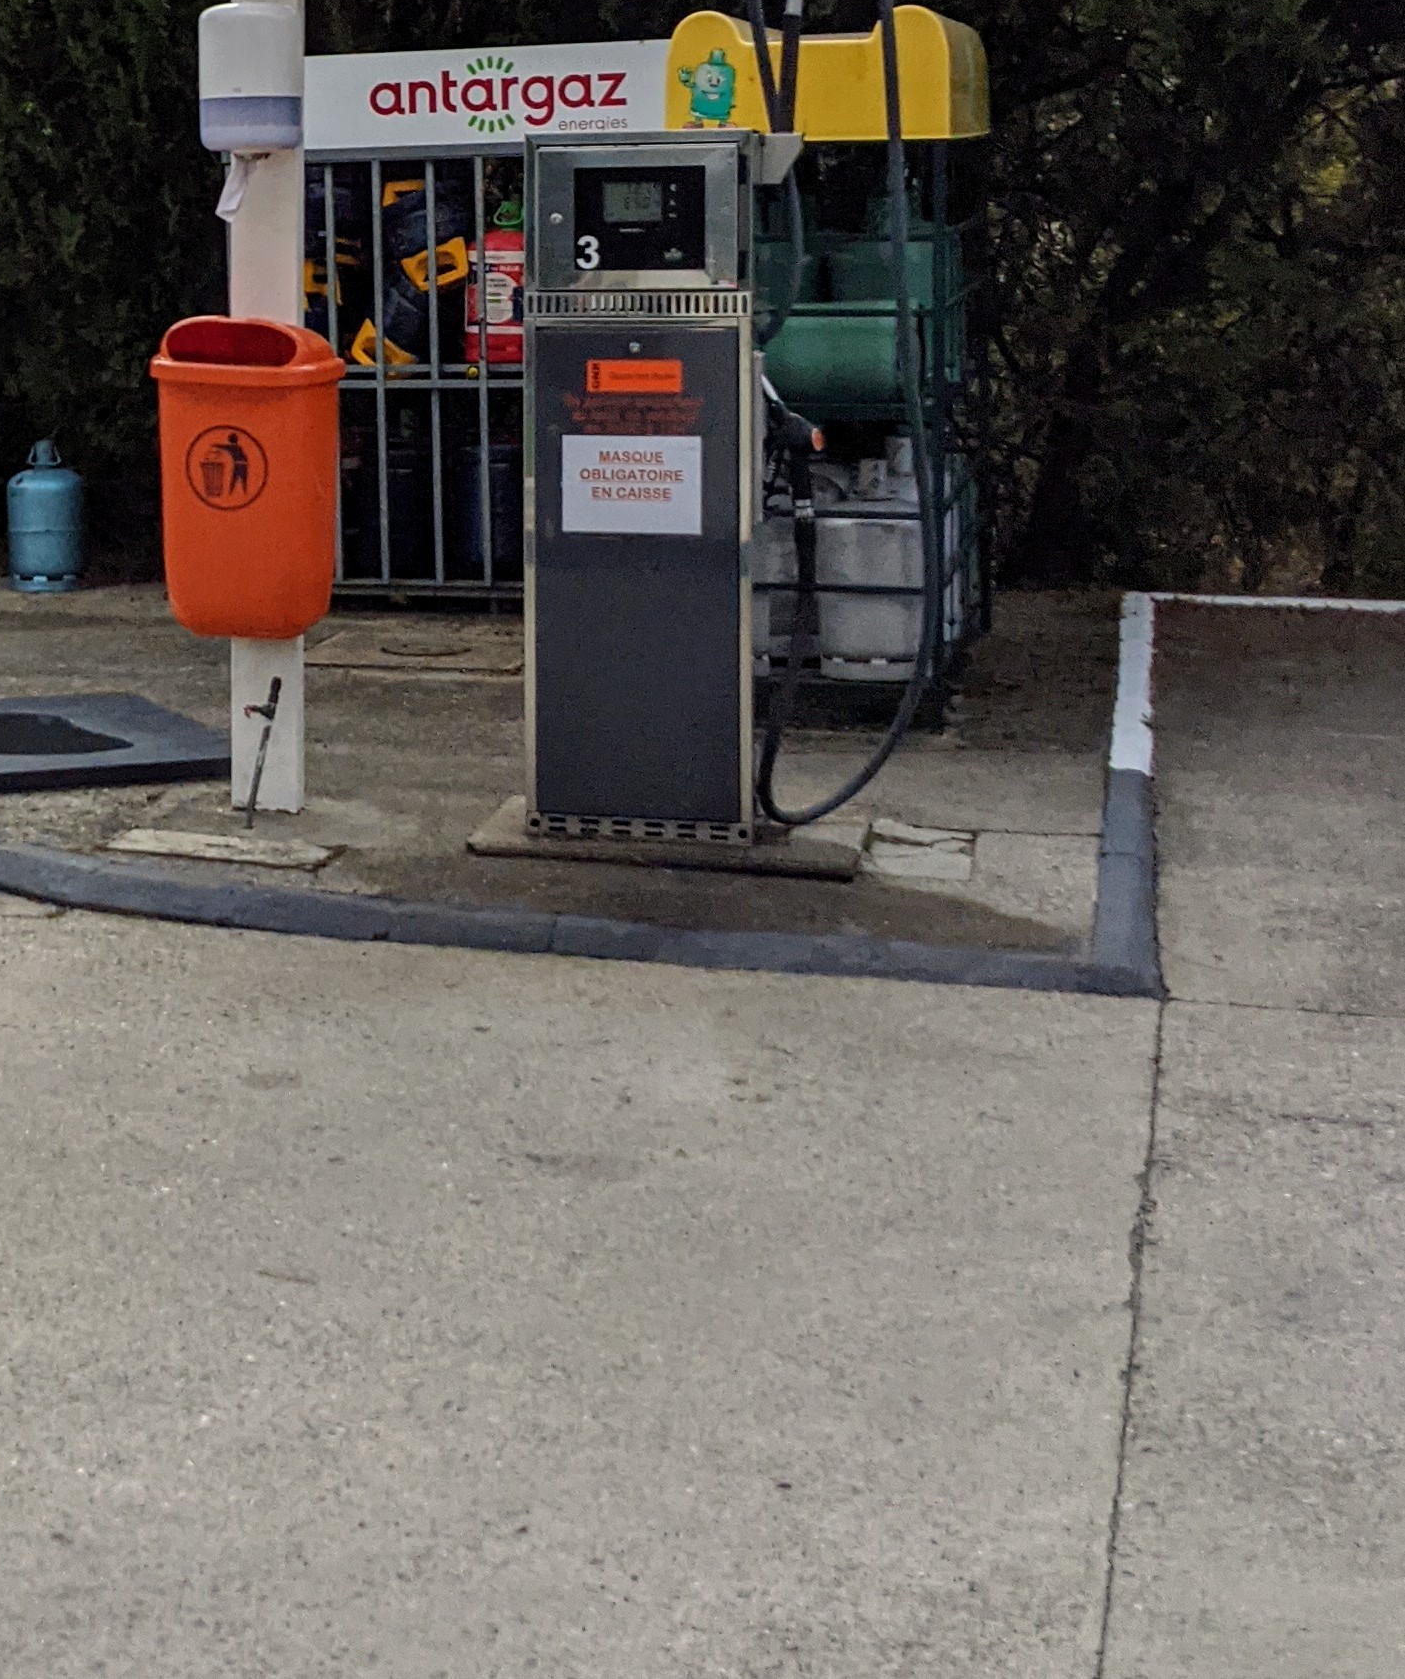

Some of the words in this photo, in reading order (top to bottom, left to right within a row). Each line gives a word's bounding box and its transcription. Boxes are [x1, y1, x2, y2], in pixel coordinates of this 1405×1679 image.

[369, 69, 628, 126] antargaz
[558, 115, 629, 132] energies
[576, 234, 601, 270] 3
[598, 450, 664, 464] MASQUE
[579, 468, 684, 482] OBLIGATOIRE
[591, 486, 612, 499] EN
[616, 487, 672, 500] CAISSE
